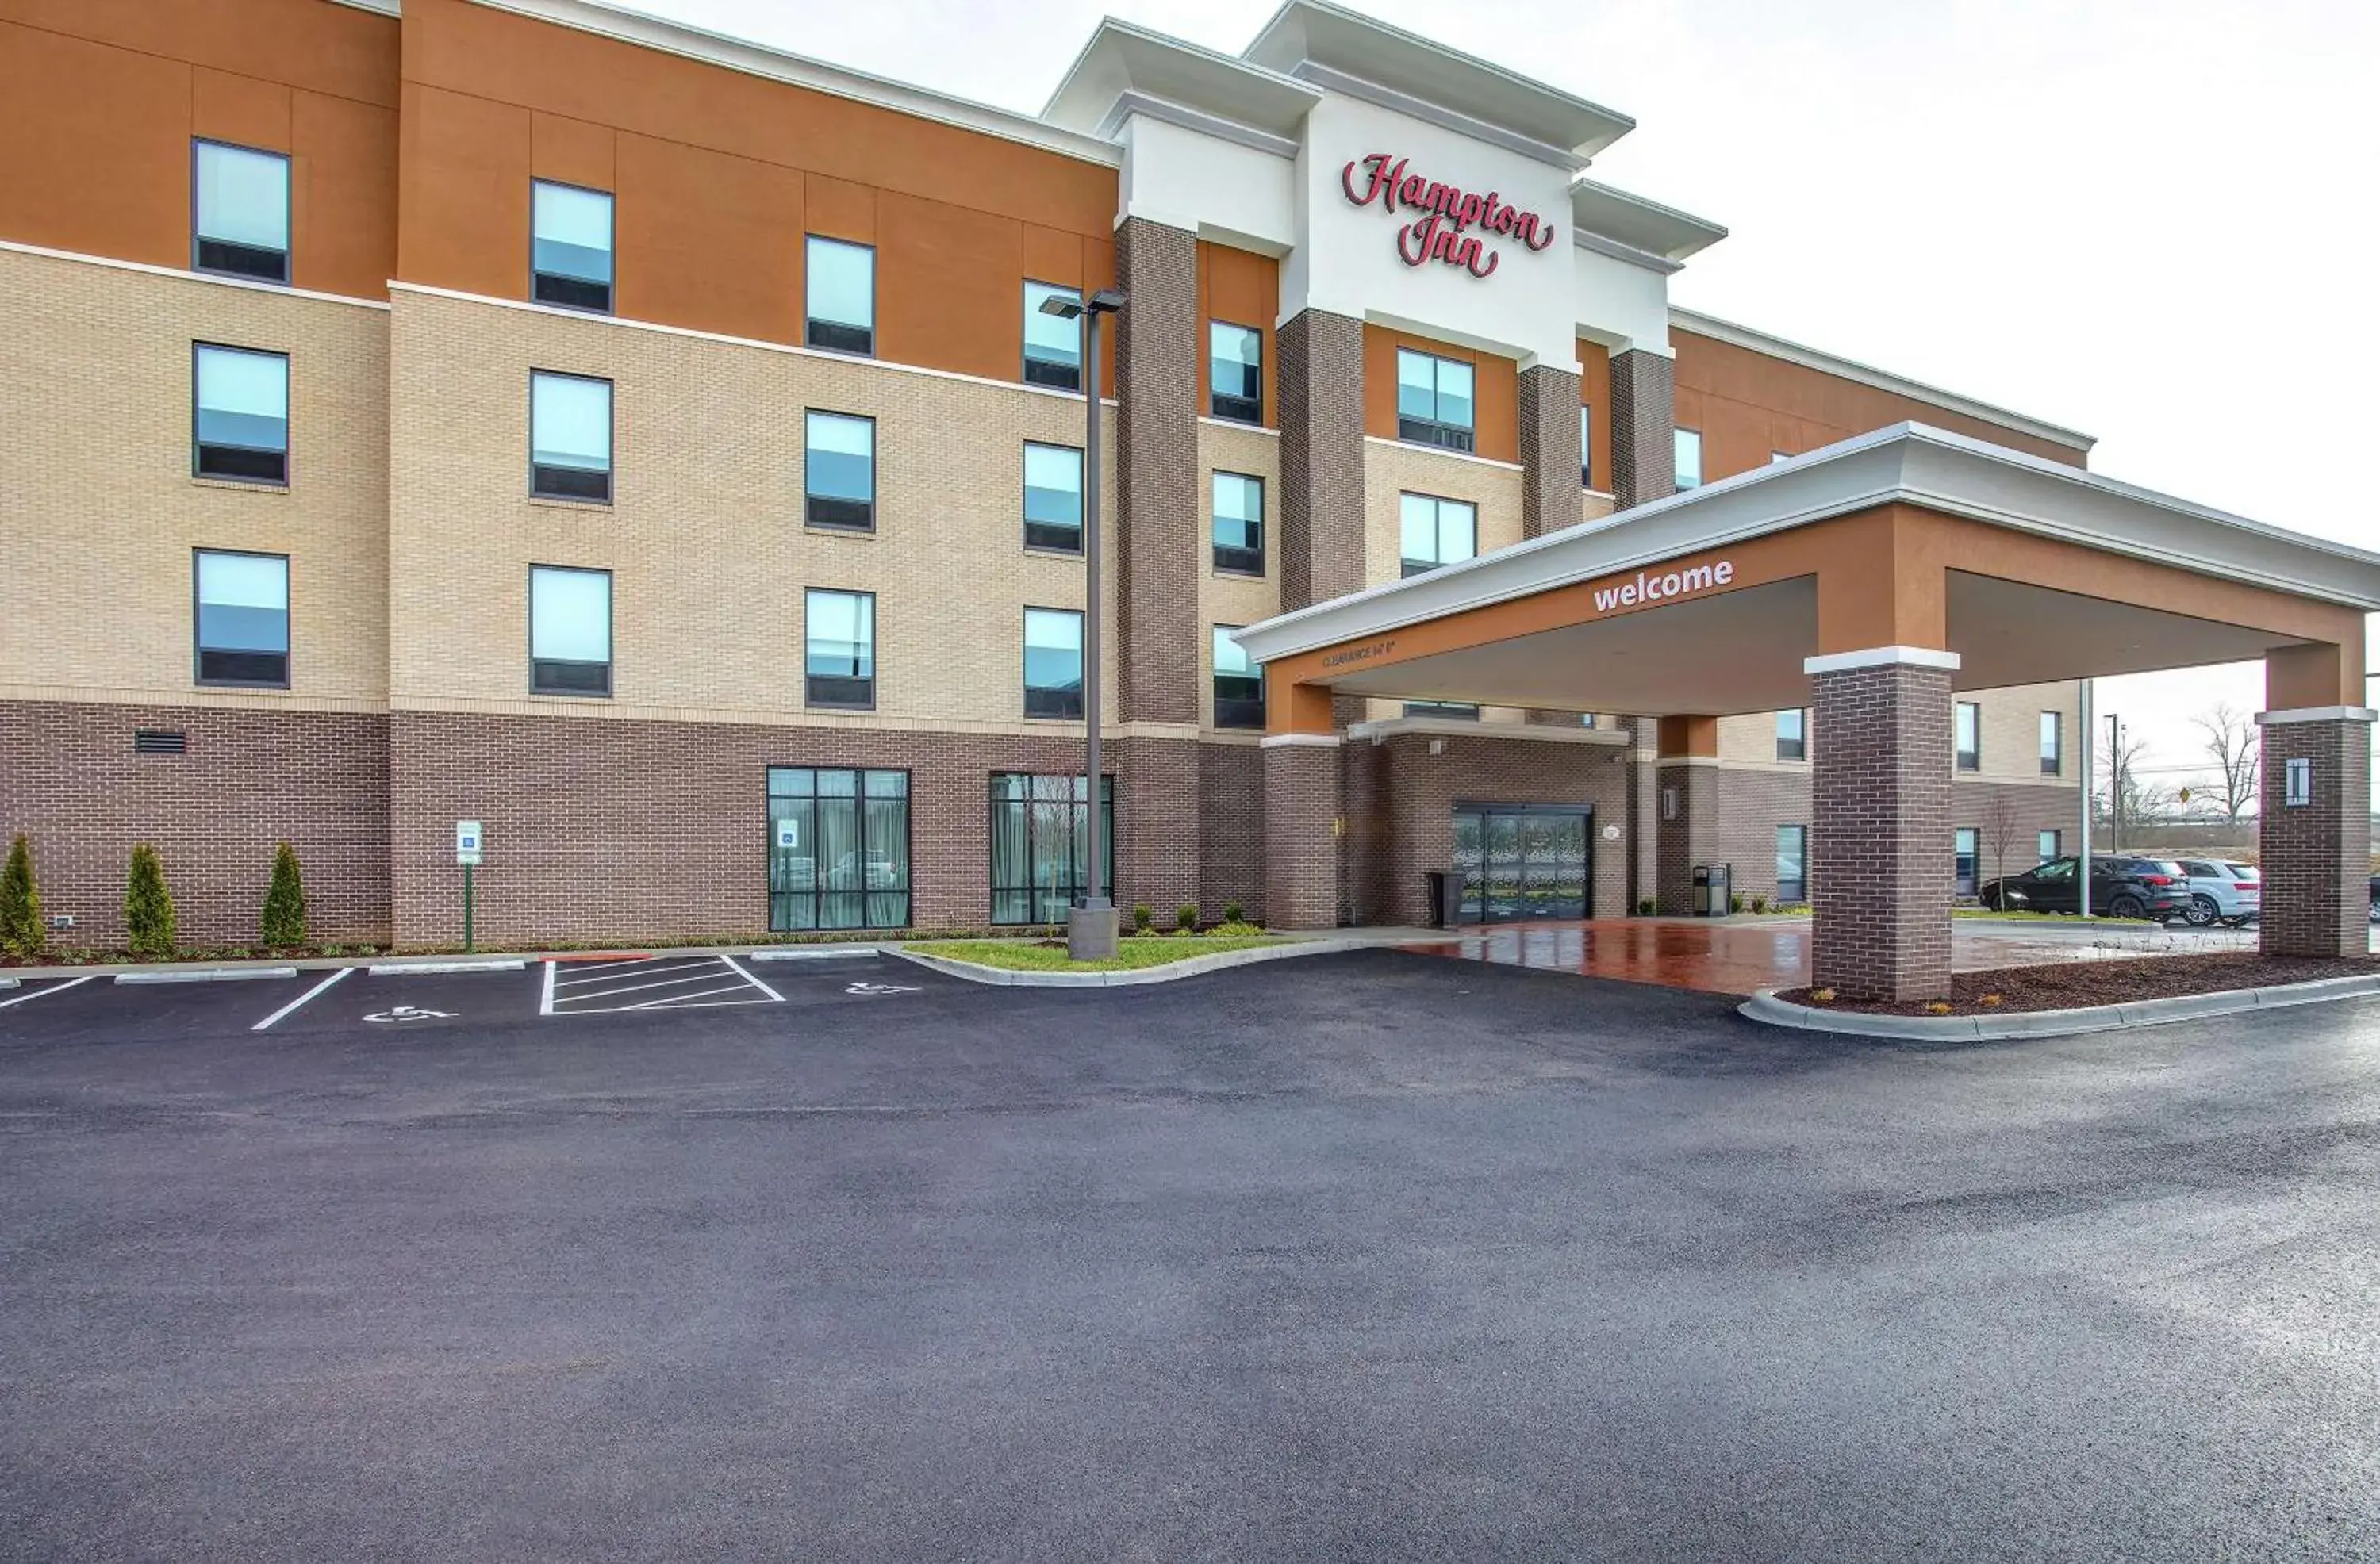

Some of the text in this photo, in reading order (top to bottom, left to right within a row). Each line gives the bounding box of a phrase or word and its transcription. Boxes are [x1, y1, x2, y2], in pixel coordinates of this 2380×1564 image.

[1342, 154, 1554, 251] Hampton
[1398, 216, 1499, 278] Inn
[1594, 560, 1734, 612] welcome
